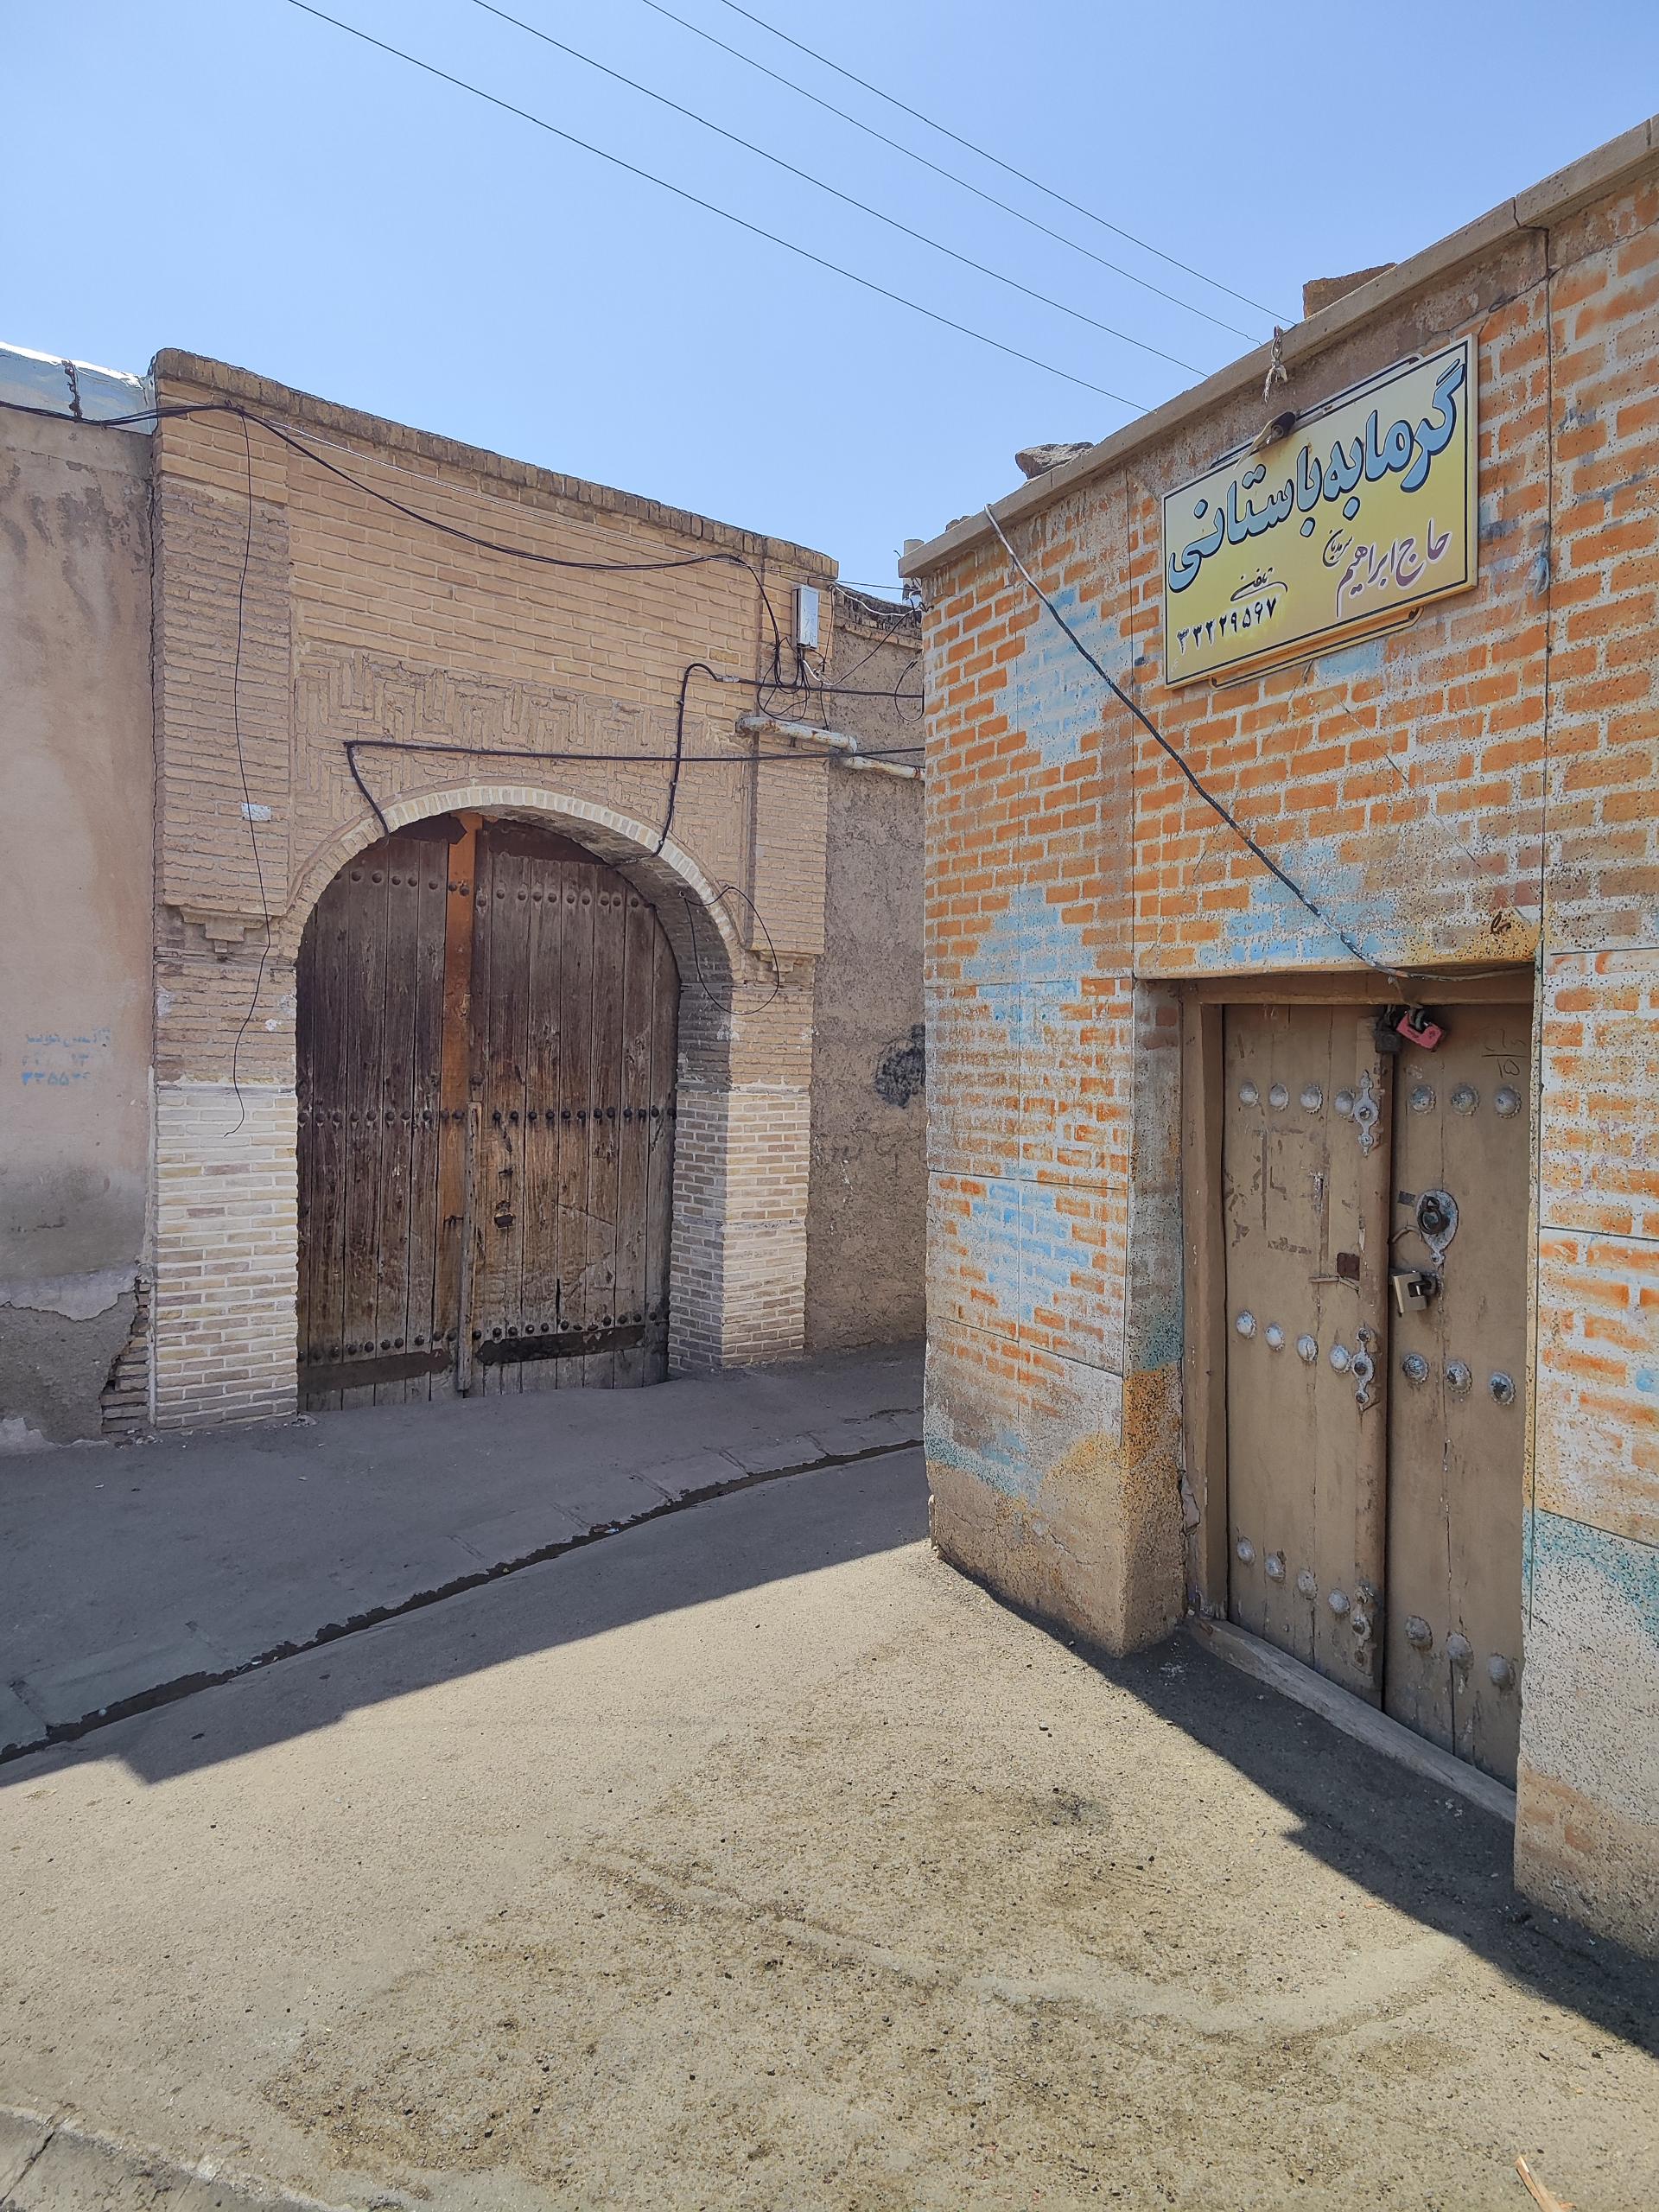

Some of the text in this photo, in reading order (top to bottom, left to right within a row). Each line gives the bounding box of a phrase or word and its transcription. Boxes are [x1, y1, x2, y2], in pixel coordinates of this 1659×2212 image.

[1168, 359, 1465, 593] گرمابه باستانی
[1336, 540, 1396, 618] ابراهیم
[1395, 519, 1451, 587] حاج
